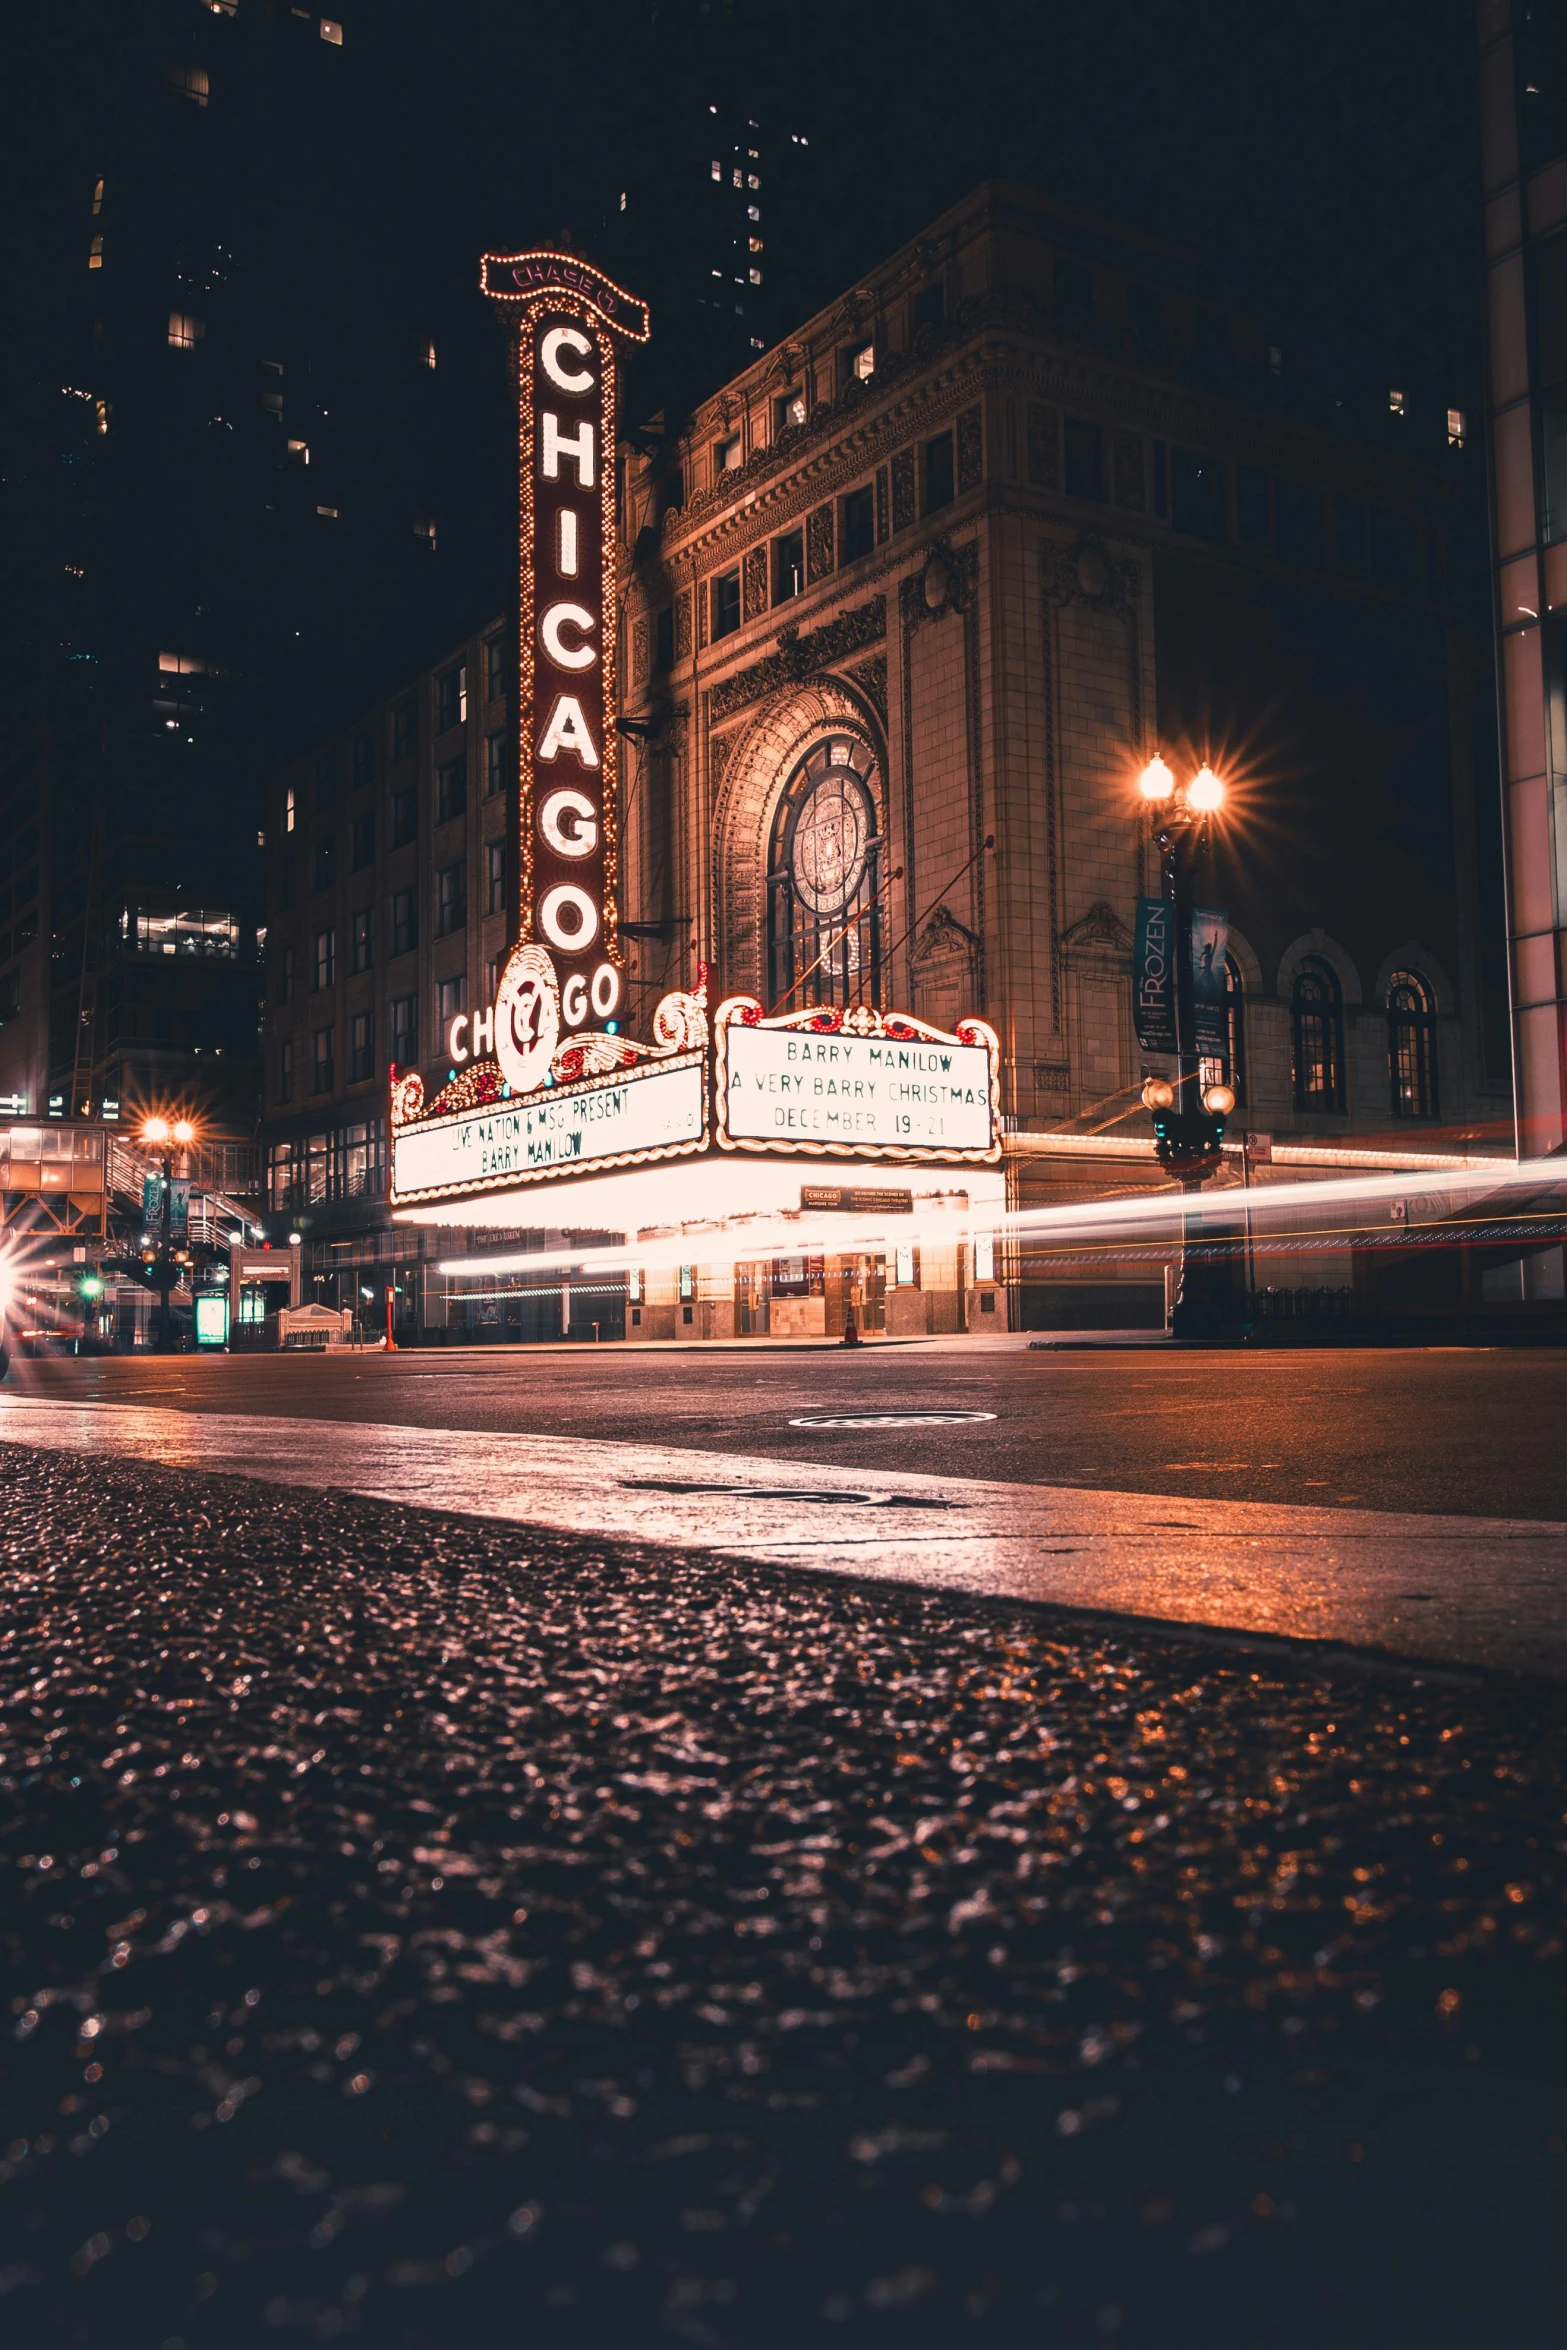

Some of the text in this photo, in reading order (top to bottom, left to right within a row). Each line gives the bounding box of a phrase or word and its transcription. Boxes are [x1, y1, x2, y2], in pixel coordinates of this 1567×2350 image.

[512, 264, 594, 296] CHASE
[540, 326, 599, 949] CHICAGO
[1139, 905, 1169, 1008] FROZEN
[787, 1041, 952, 1073] BARRY MANILOW
[730, 1071, 987, 1105] A VERY BARRY CHRISTMAS
[479, 1114, 520, 1144] NATION
[538, 1104, 565, 1129] MSG
[573, 1088, 629, 1126] PRESENT
[774, 1107, 876, 1132] DECEMBER
[482, 1130, 583, 1174] BARRY MANILOW
